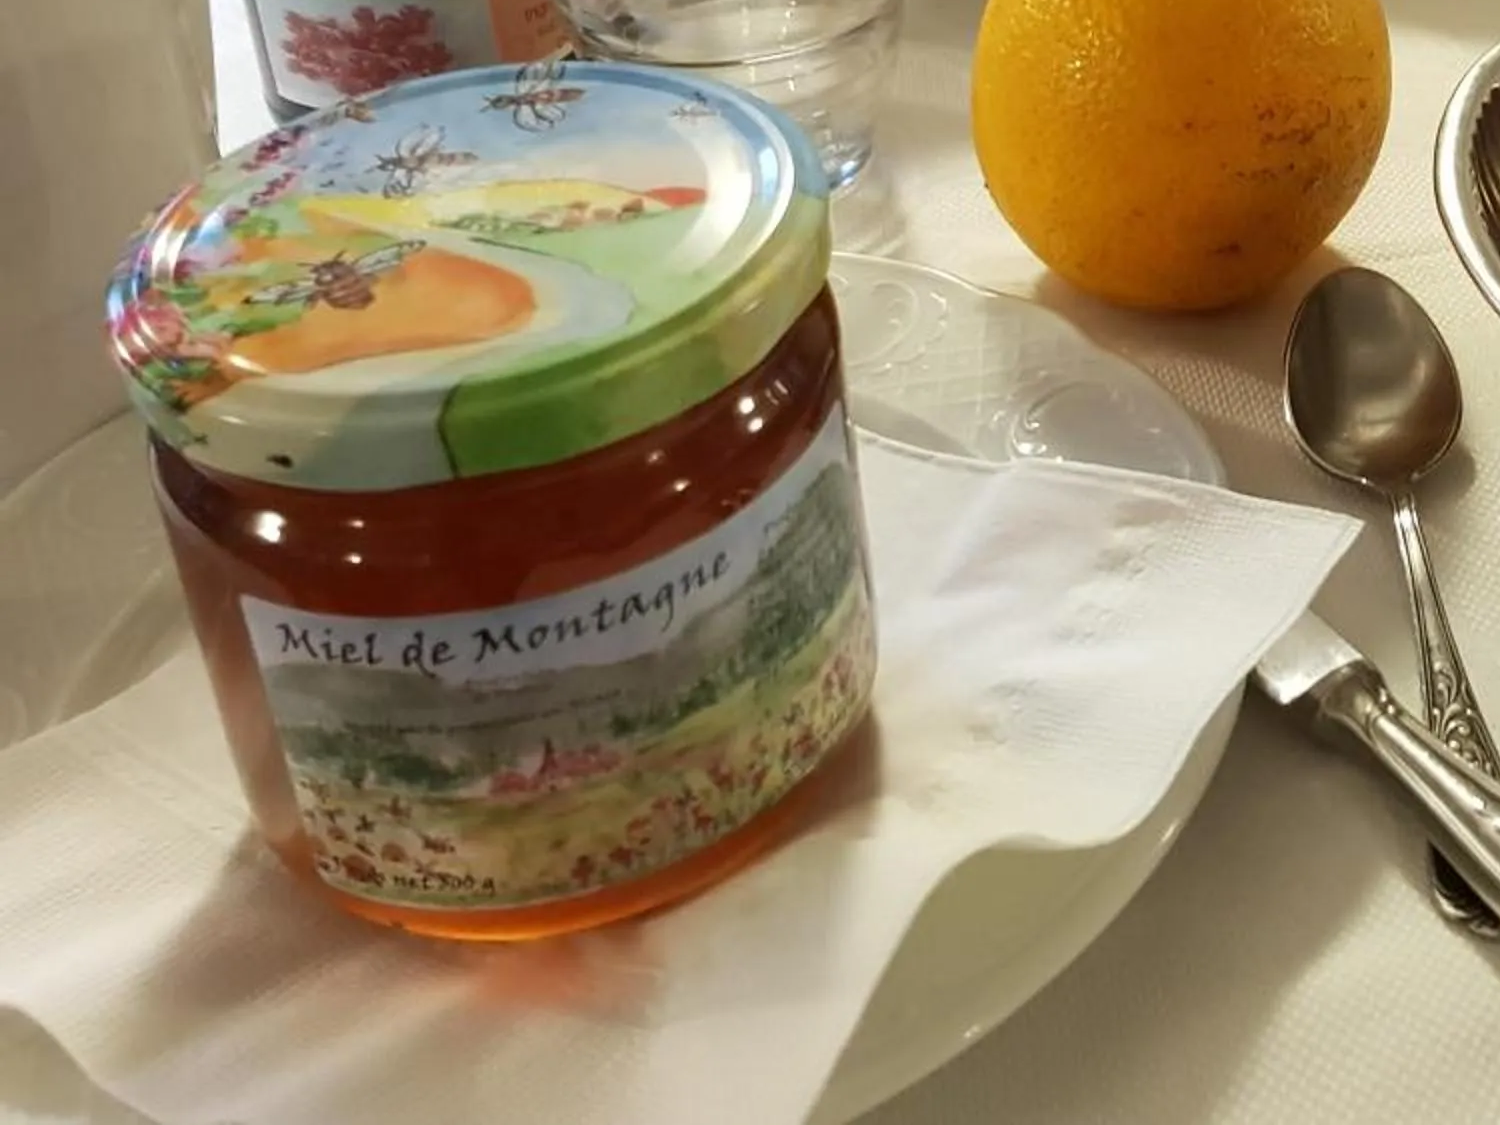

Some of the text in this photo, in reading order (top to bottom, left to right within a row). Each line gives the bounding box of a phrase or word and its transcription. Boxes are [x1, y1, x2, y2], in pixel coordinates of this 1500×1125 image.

[275, 550, 732, 679] Miel de Montagne
